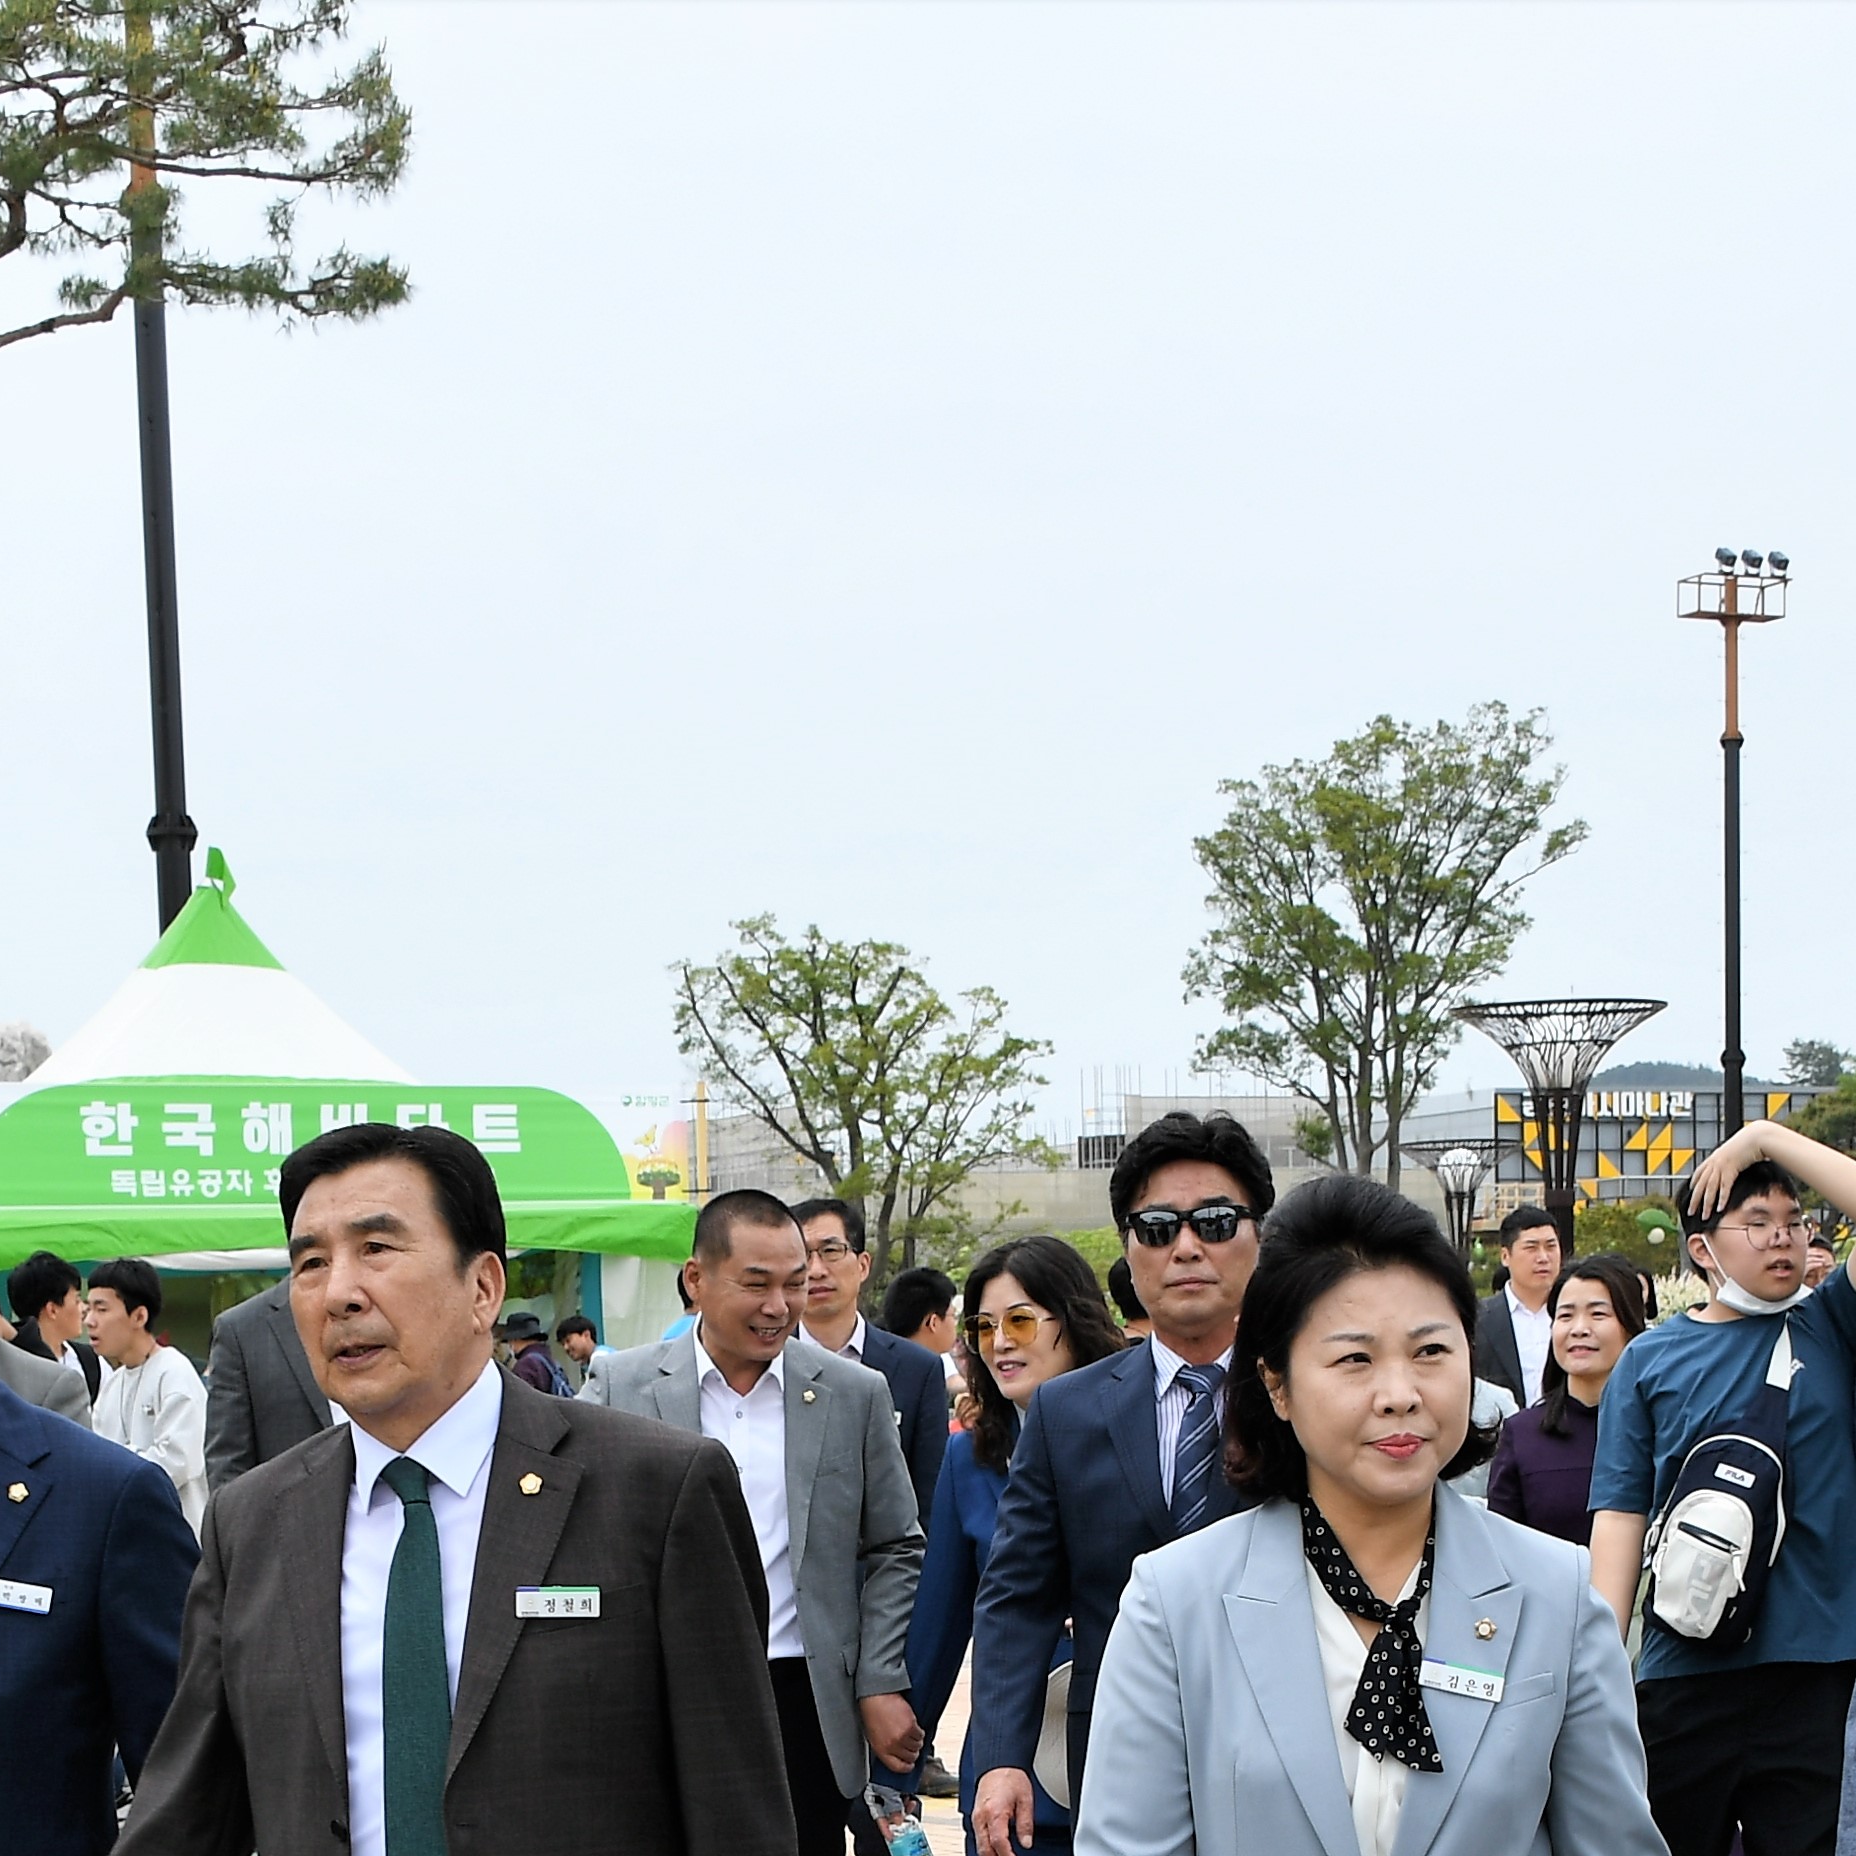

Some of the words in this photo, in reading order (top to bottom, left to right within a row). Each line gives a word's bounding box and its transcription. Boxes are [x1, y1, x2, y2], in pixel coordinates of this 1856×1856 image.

[110, 1168, 252, 1198] 독립유공자
[544, 1598, 593, 1613] 정철희
[1447, 1675, 1495, 1697] 김은영
